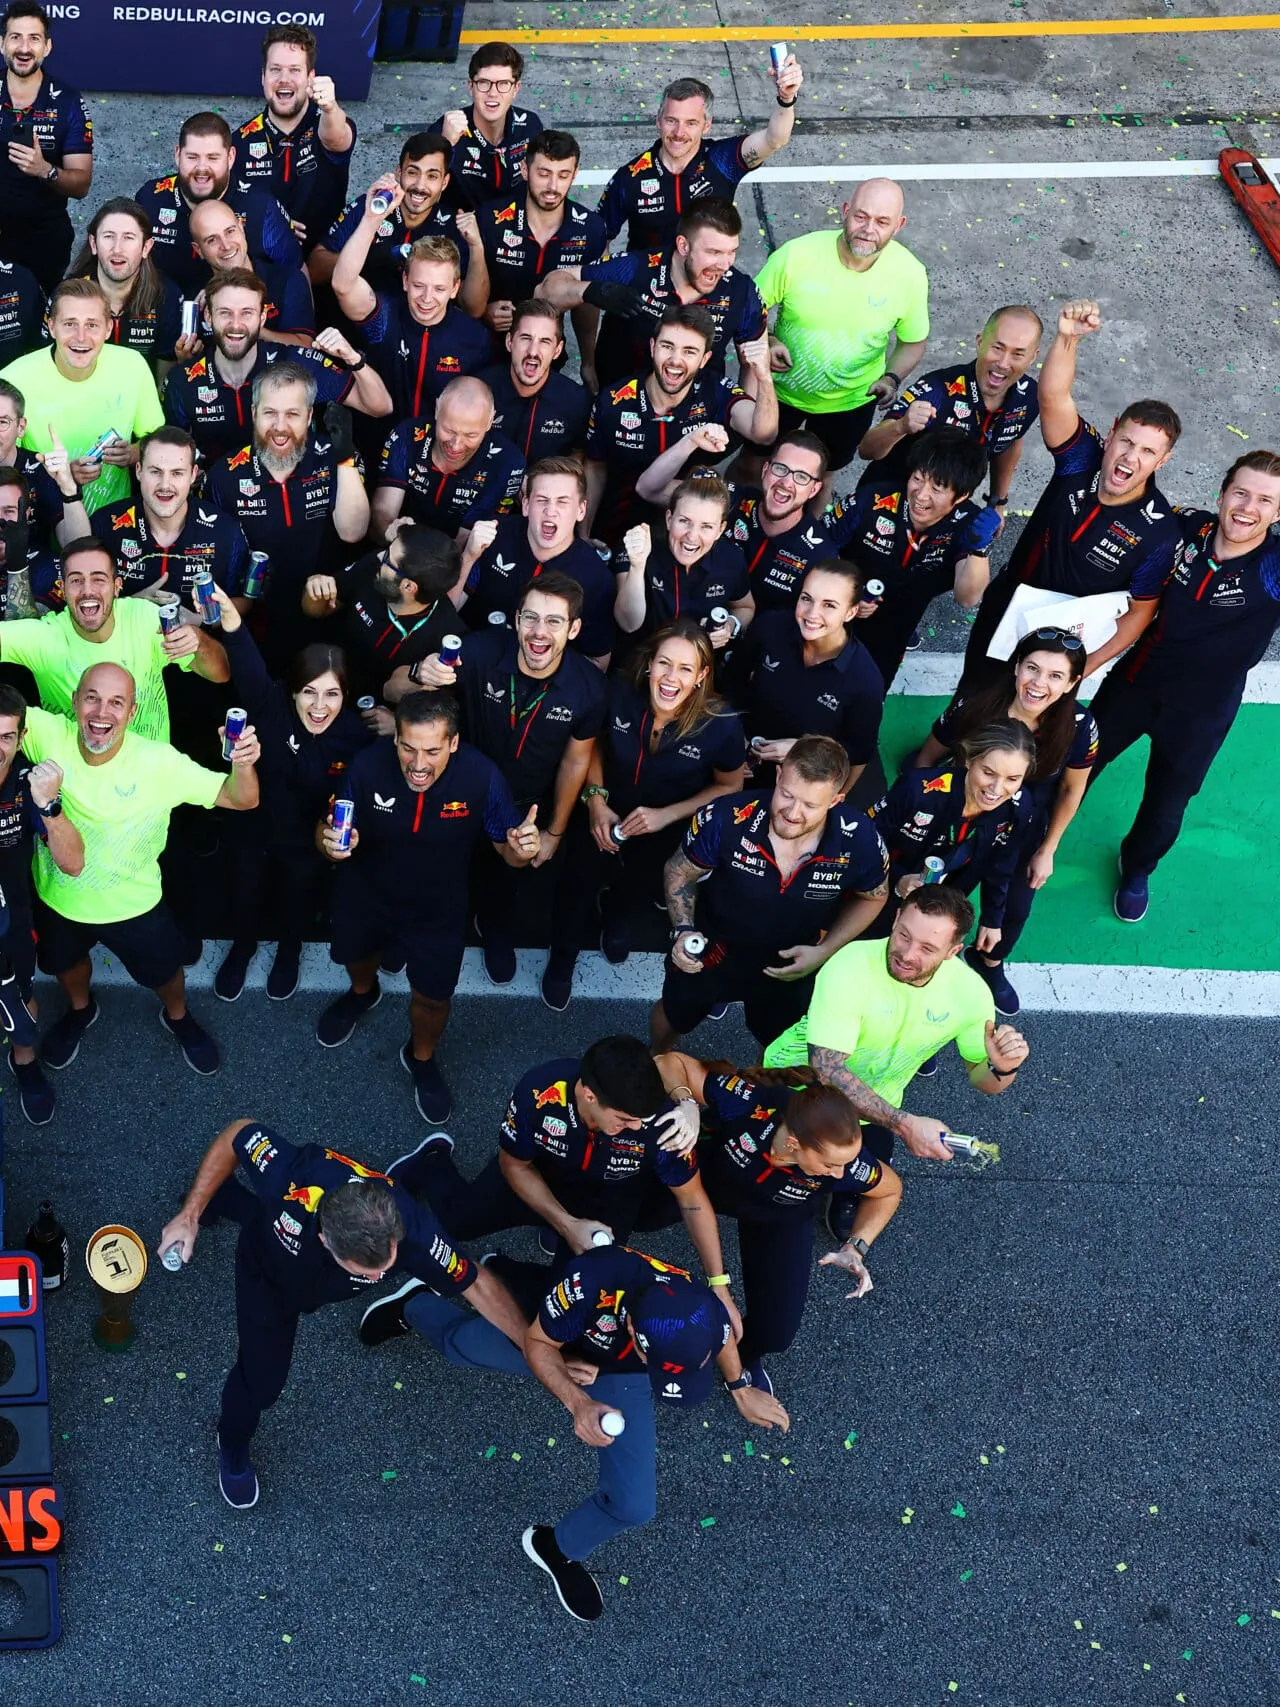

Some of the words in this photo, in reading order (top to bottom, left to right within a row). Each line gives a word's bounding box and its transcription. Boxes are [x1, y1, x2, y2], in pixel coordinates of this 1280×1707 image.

[113, 6, 325, 27] REDBULLRACING.COM
[474, 129, 487, 148] zoom
[246, 161, 264, 169] Mobil
[638, 205, 664, 213] ORACLE
[496, 248, 516, 258] Mobil
[560, 254, 582, 262] BYBIT
[496, 258, 523, 266] ORACLE
[0, 311, 20, 322] BYBIT
[131, 328, 154, 336] BYBIT
[970, 382, 978, 403] zoom
[639, 390, 647, 412] zoom
[195, 406, 215, 414] Mobil
[252, 456, 261, 477] zoom
[306, 486, 330, 501] BYBIT
[456, 488, 478, 499] BYBIT
[237, 499, 257, 508] Mobil
[305, 499, 330, 508] HONDA
[138, 518, 146, 541] zoom
[1113, 520, 1142, 541] ORACLE
[863, 539, 891, 555] ORACLE
[1100, 538, 1126, 558] BYBIT
[778, 549, 808, 564] ORACLE
[1092, 546, 1120, 564] HONDA
[185, 563, 212, 573] BYBIT
[769, 568, 796, 583] BYBIT
[763, 578, 792, 592] HONDA
[749, 809, 767, 832] zoom
[733, 851, 757, 865] Mobil
[731, 861, 765, 877] ORACLE
[812, 871, 842, 881] BYBIT
[808, 882, 841, 890] HONDA
[568, 1102, 577, 1128] zoom
[534, 1132, 559, 1148] Mobil
[610, 1156, 640, 1167] BYBIT
[785, 1185, 810, 1197] BYBIT
[572, 1272, 584, 1301] Mobil
